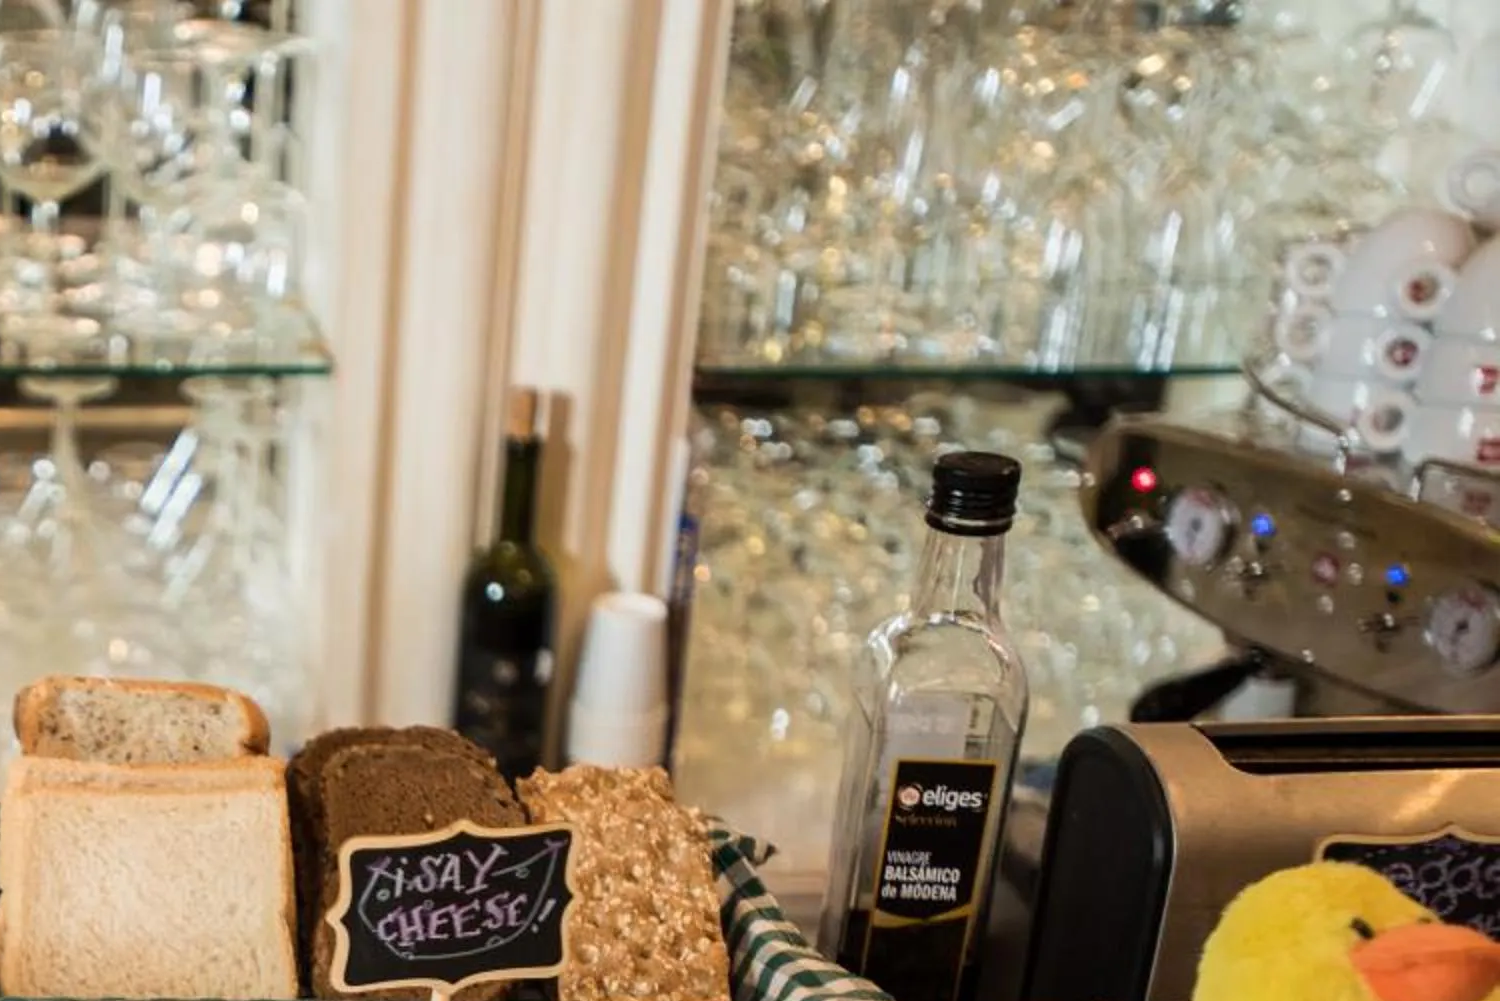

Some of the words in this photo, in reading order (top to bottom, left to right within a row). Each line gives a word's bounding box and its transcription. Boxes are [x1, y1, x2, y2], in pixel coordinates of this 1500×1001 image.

[922, 784, 983, 812] eliges
[412, 843, 509, 896] SAY
[887, 850, 932, 865] VINAGRE
[884, 863, 961, 884] BALSÁMICO
[881, 883, 897, 899] de
[376, 891, 557, 948] CHEESE!
